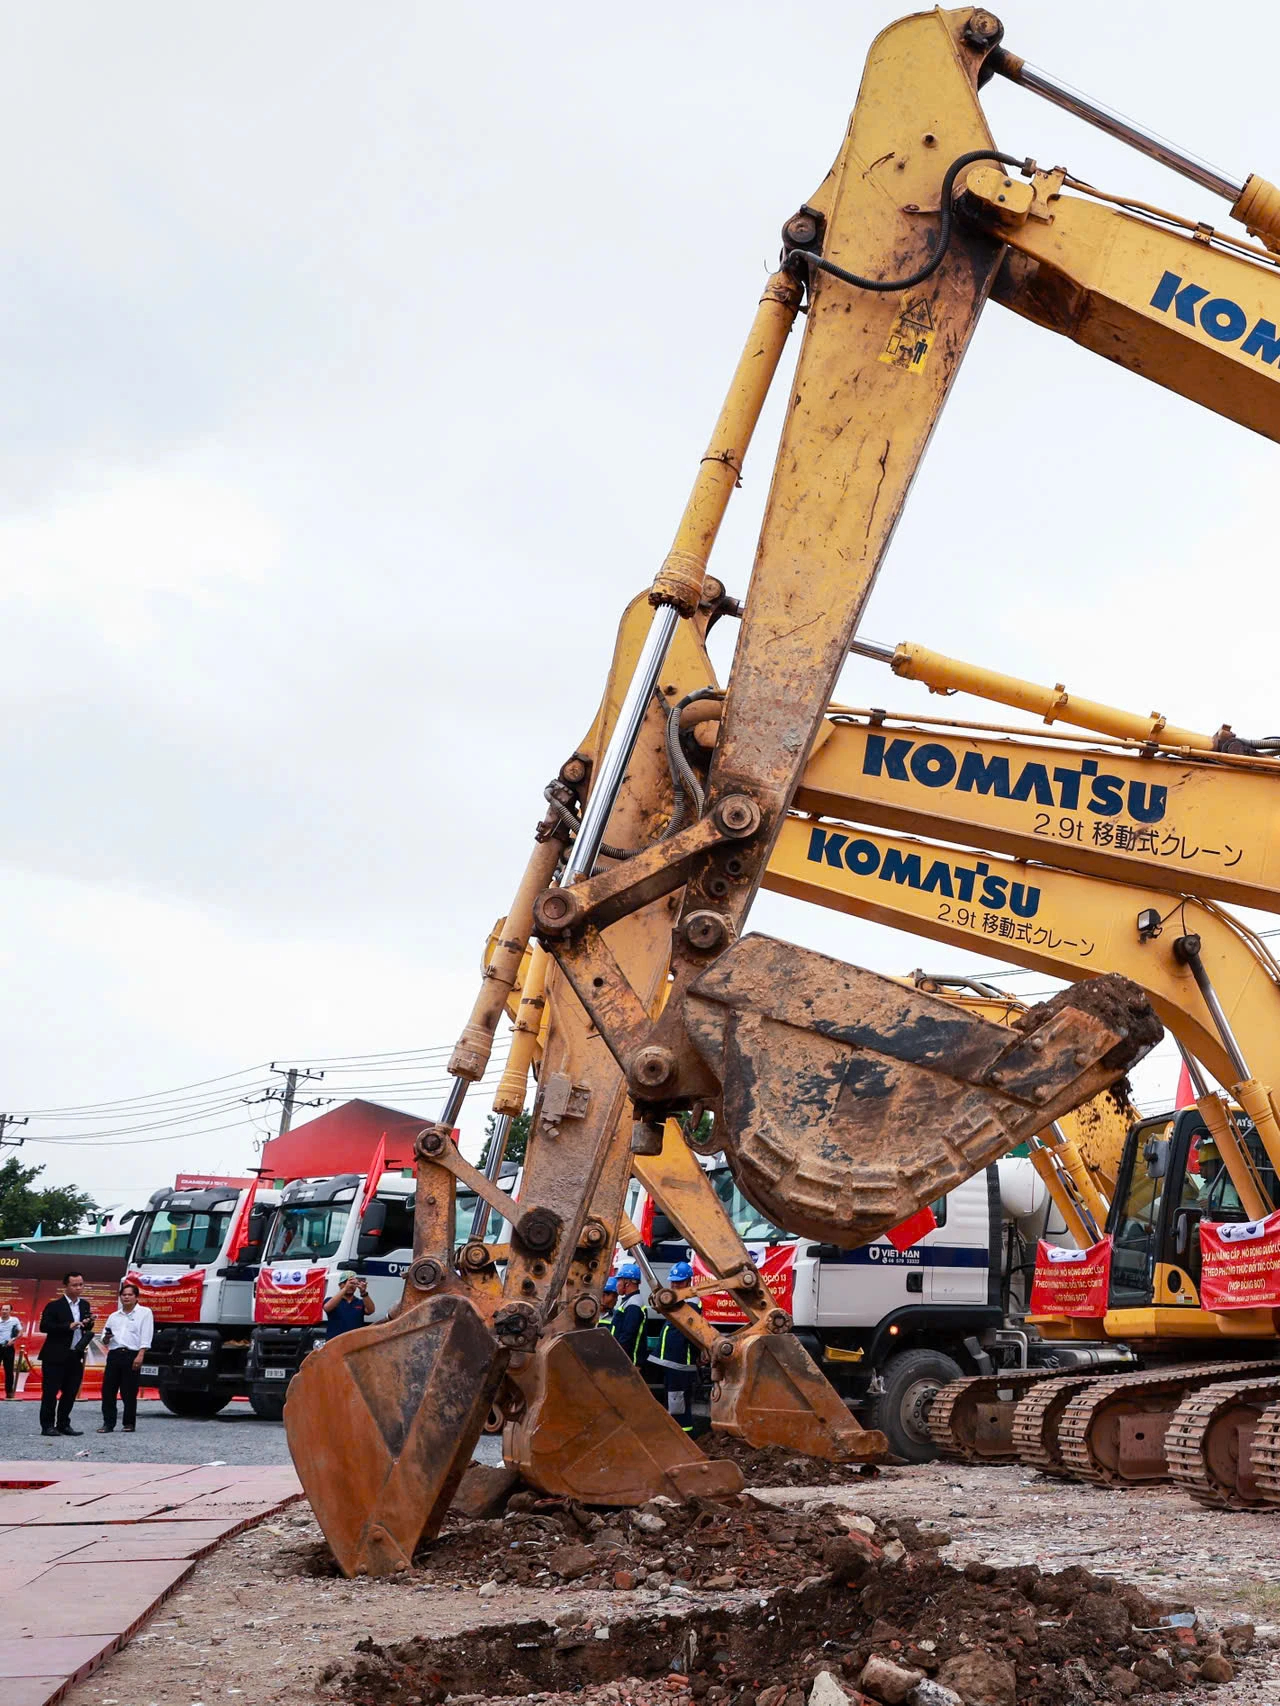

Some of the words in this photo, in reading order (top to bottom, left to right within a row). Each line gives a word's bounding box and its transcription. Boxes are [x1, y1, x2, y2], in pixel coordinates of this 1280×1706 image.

[862, 733, 1168, 824] KOMATSU
[807, 827, 1041, 918] KOMATSU
[1033, 813, 1084, 842] 2.9t
[1092, 820, 1244, 867] 移動式クレーン
[937, 903, 977, 930] 2.9t
[981, 912, 1095, 957] 移動式クレーン
